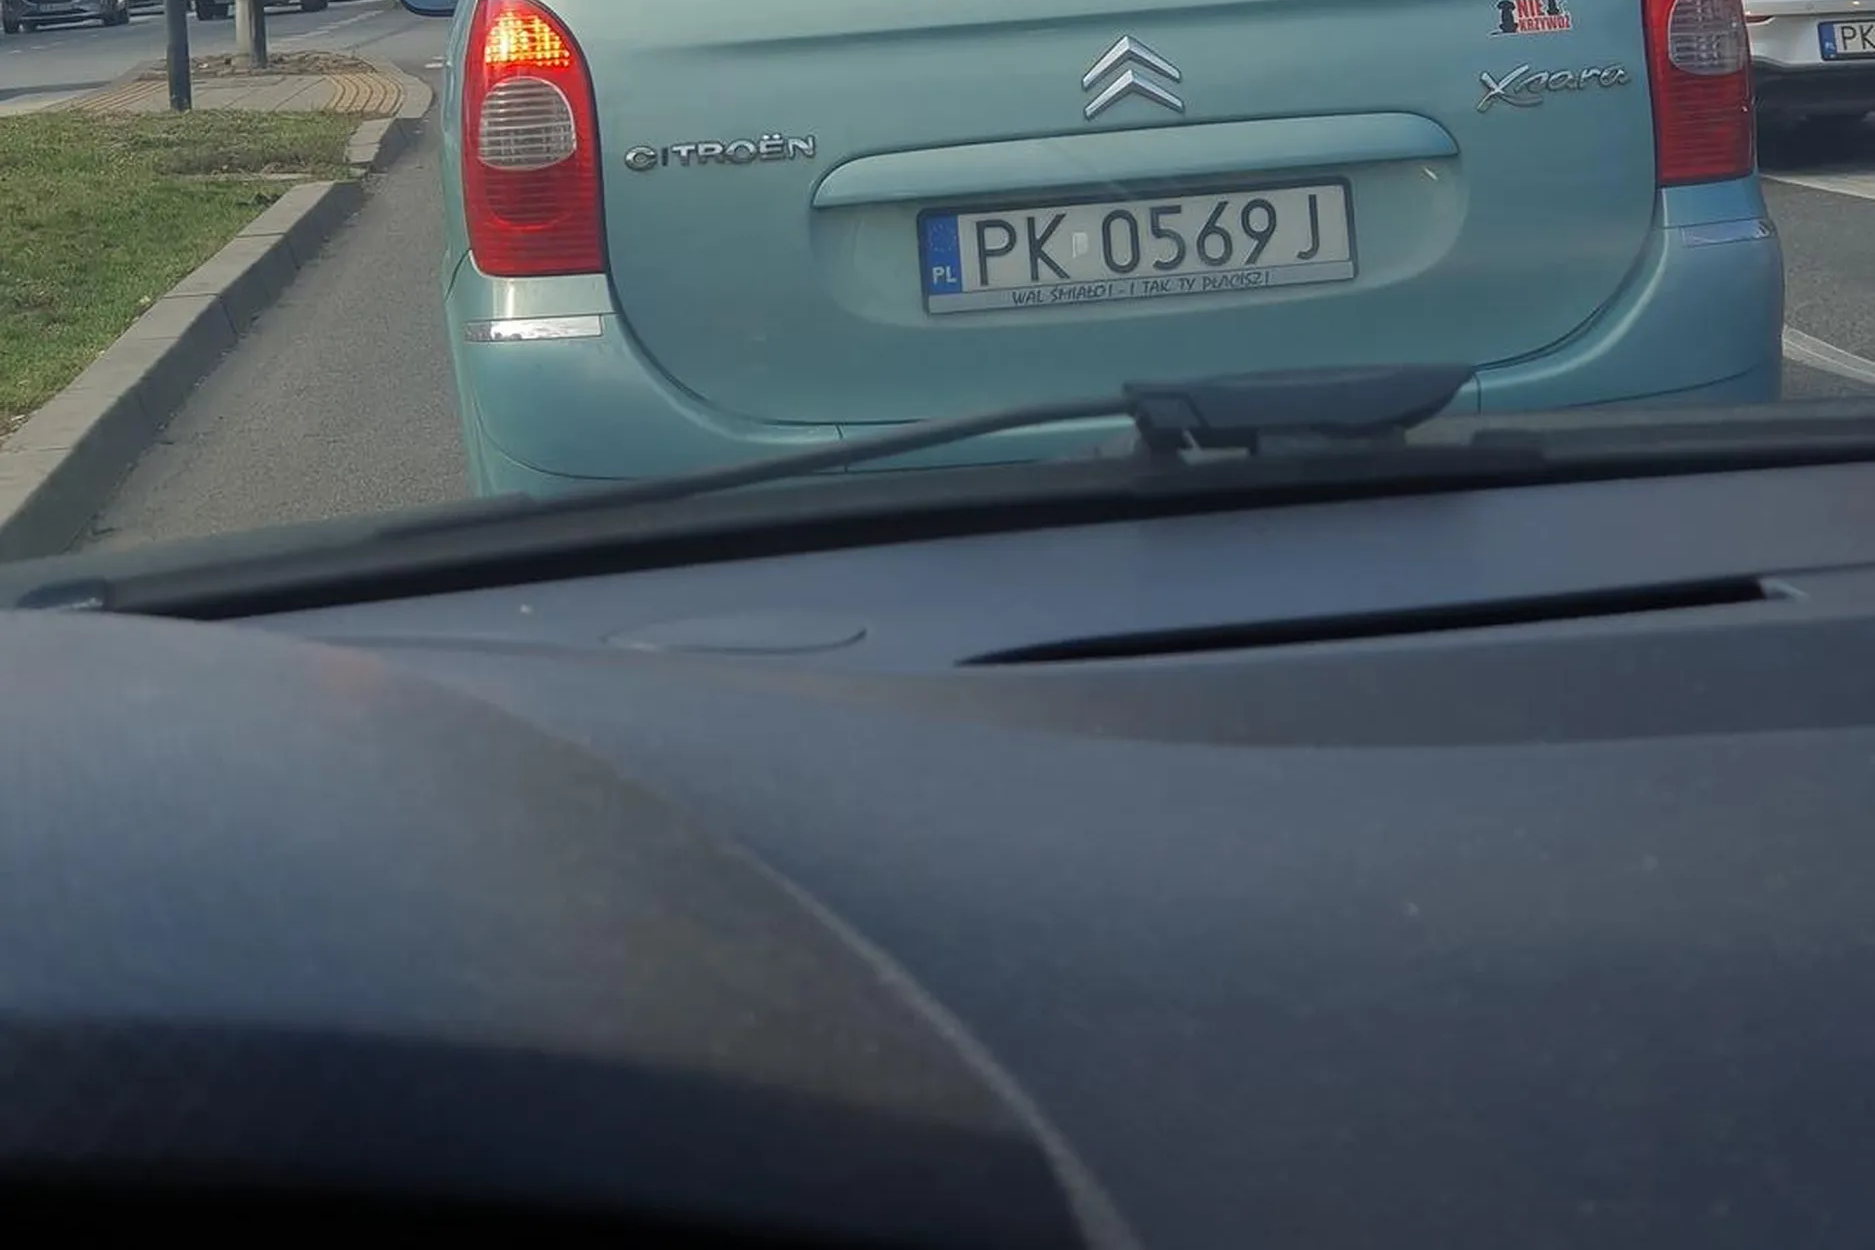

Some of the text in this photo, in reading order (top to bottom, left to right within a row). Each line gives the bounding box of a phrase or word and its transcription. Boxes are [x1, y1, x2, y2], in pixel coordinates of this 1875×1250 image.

[1841, 24, 1875, 51] PK
[1476, 62, 1632, 113] Xsara
[623, 132, 817, 172] CITROËN
[975, 193, 1321, 287] PK 0569J
[931, 265, 958, 285] PL
[1011, 289, 1044, 306] WAL
[1141, 278, 1170, 295] TAK
[1178, 276, 1196, 291] TY
